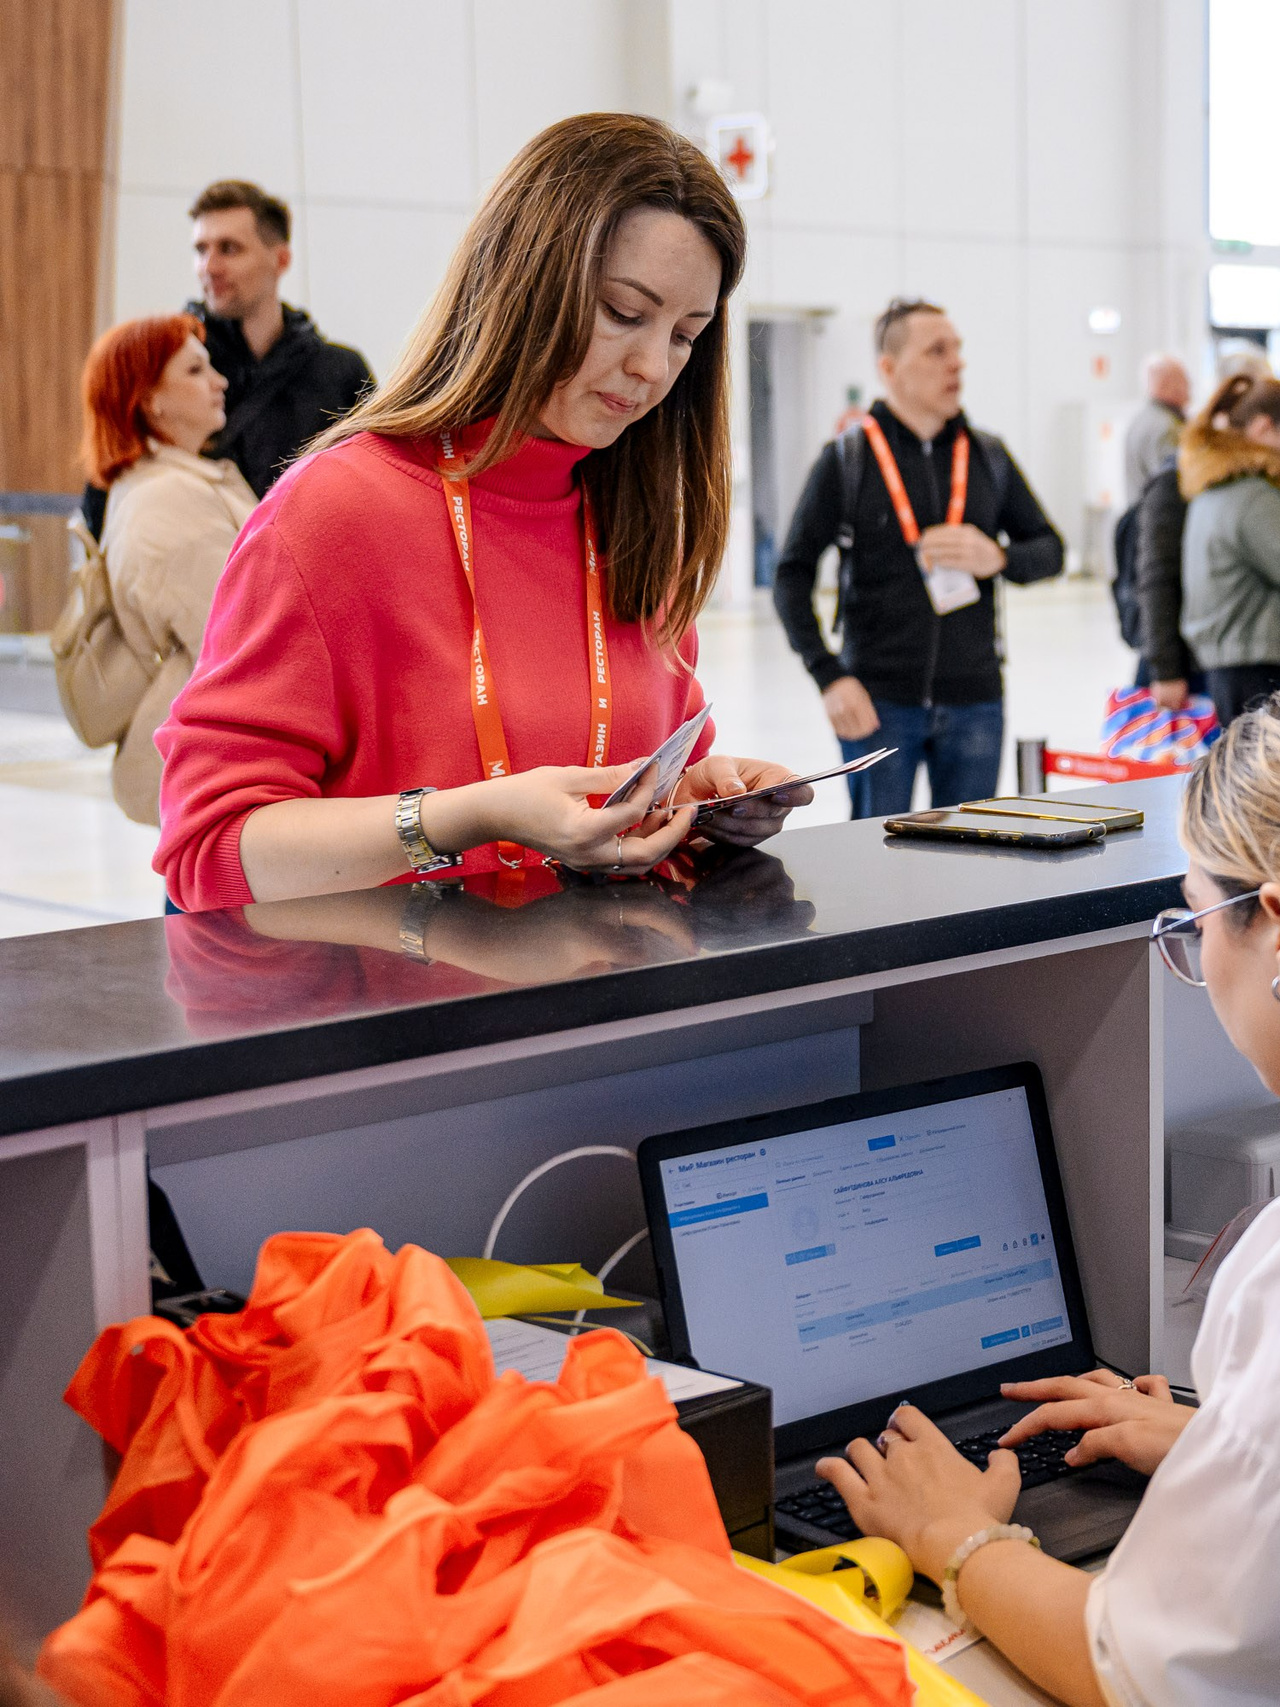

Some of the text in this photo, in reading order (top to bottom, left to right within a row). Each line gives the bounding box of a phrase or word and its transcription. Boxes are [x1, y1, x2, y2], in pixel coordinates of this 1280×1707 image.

[452, 496, 471, 572] РЕСТОРАН
[592, 611, 607, 684] РЕСТОРАН
[598, 698, 608, 709] И
